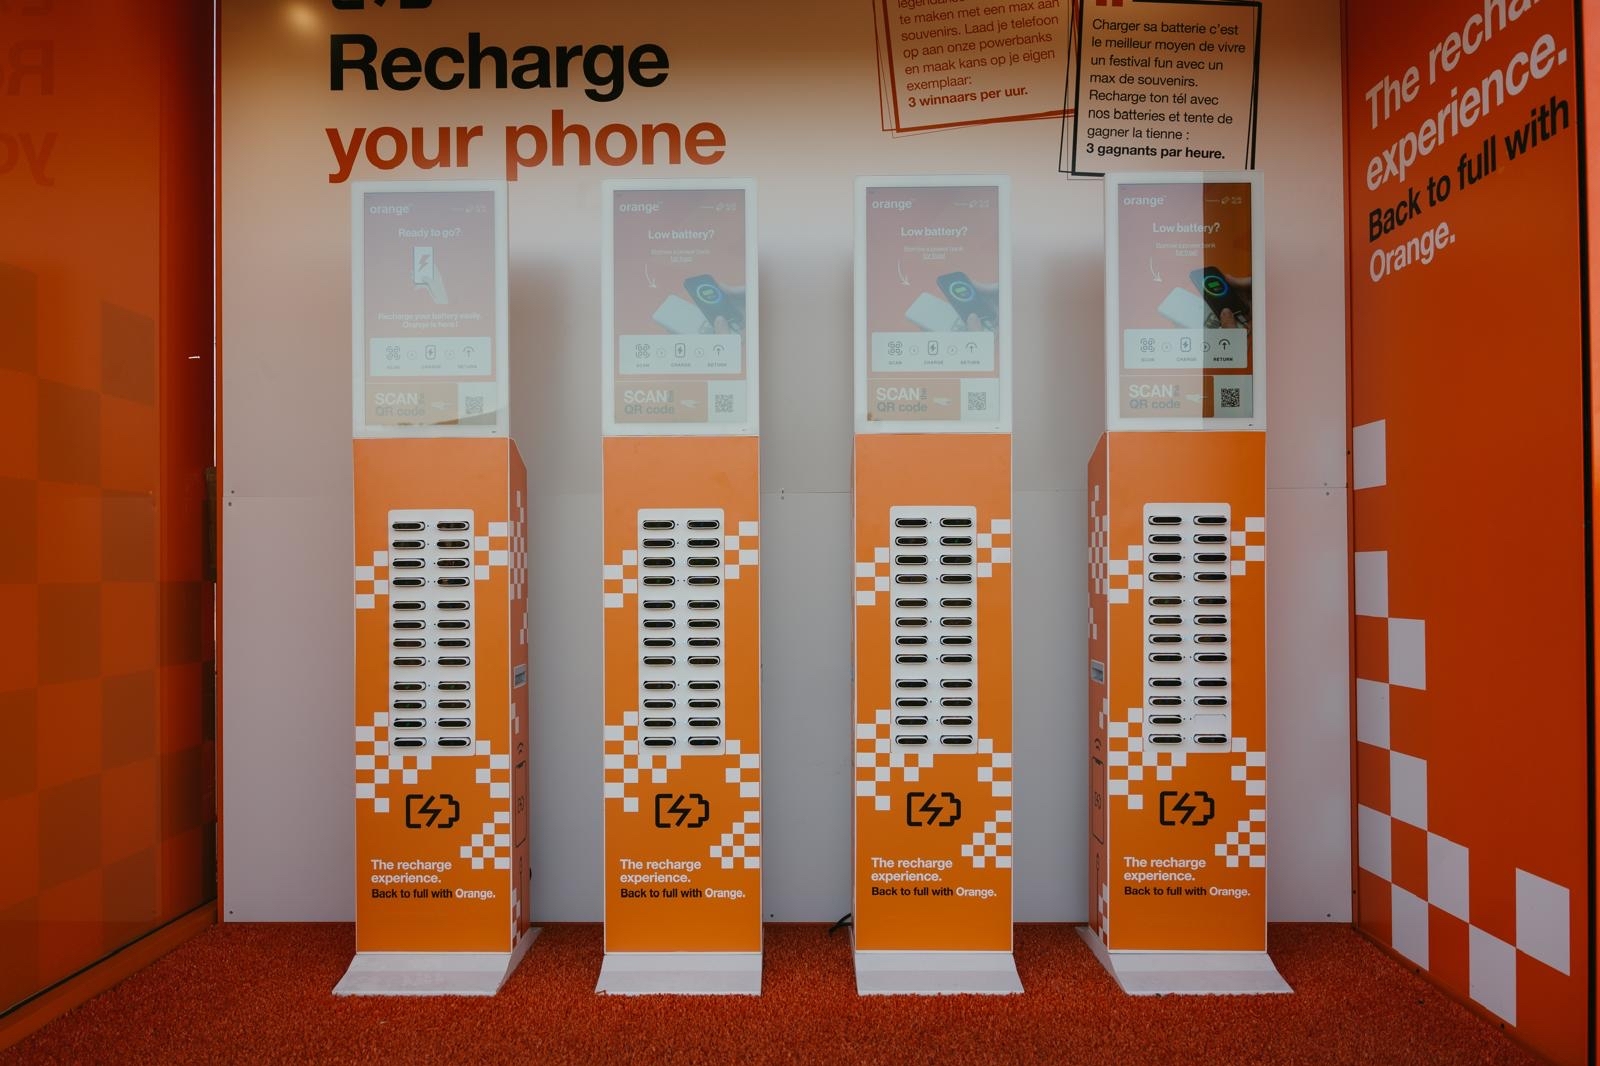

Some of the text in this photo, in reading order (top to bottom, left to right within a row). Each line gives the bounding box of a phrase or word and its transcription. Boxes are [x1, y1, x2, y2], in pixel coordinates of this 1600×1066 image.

[900, 1, 1060, 24] te maken met een max aan
[901, 15, 1058, 41] souvenirs. Laad je telefoon
[1093, 19, 1238, 35] Charger sa batterie c’est
[903, 32, 1052, 59] op aan onze powerbanks
[1092, 36, 1246, 53] le meilleur moyen de vivre
[330, 32, 670, 102] Recharge
[905, 50, 1055, 74] en maak kans op je eigen
[1091, 54, 1223, 70] un festival fun avec un
[1365, 0, 1538, 129] The recha
[907, 76, 972, 91] exemplaar:
[1090, 73, 1198, 87] max de souvenirs.
[909, 86, 1028, 108] 3 winnaars per uur.
[1090, 90, 1219, 106] Recharge ton tél avec
[1088, 108, 1232, 124] nos batteries et tente de
[1366, 34, 1568, 190] experience.
[1087, 128, 1129, 139] gagner
[1133, 127, 1142, 138] la
[1146, 128, 1182, 139] tienne
[325, 110, 726, 184] your phone
[1086, 143, 1225, 159] 3 gagnants par heure.
[1369, 96, 1569, 242] Back to full with
[619, 202, 660, 213] orange
[872, 200, 912, 211] orange
[1124, 196, 1164, 207] orange
[370, 205, 409, 215] orange
[398, 228, 429, 238] Ready
[431, 228, 441, 237] to
[901, 227, 968, 237] Low battery?
[1153, 222, 1220, 233] Low battery?
[648, 230, 714, 240] Low battery?
[1370, 222, 1456, 282] Orange.
[624, 390, 668, 403] SCAN
[876, 387, 920, 400] SCAN
[1129, 385, 1173, 398] SCAN
[375, 393, 418, 405] SCAN
[1130, 399, 1180, 409] QR code
[376, 406, 425, 416] QR code
[624, 404, 675, 415] QR code
[877, 402, 927, 413] QR code
[371, 860, 452, 872] The recharge
[620, 859, 702, 872] The recharge
[871, 857, 953, 871] The recharge
[1124, 856, 1206, 870] The recharge
[371, 873, 441, 884] experience.
[620, 872, 690, 884] experience.
[871, 871, 942, 883] experience.
[1124, 870, 1195, 882] experience.
[372, 889, 495, 900] Back to full with Orange.
[621, 888, 745, 899] Back to full with Orange.
[872, 887, 997, 899] Back to full with Orange.
[1124, 886, 1250, 899] Back to full with Orange.
